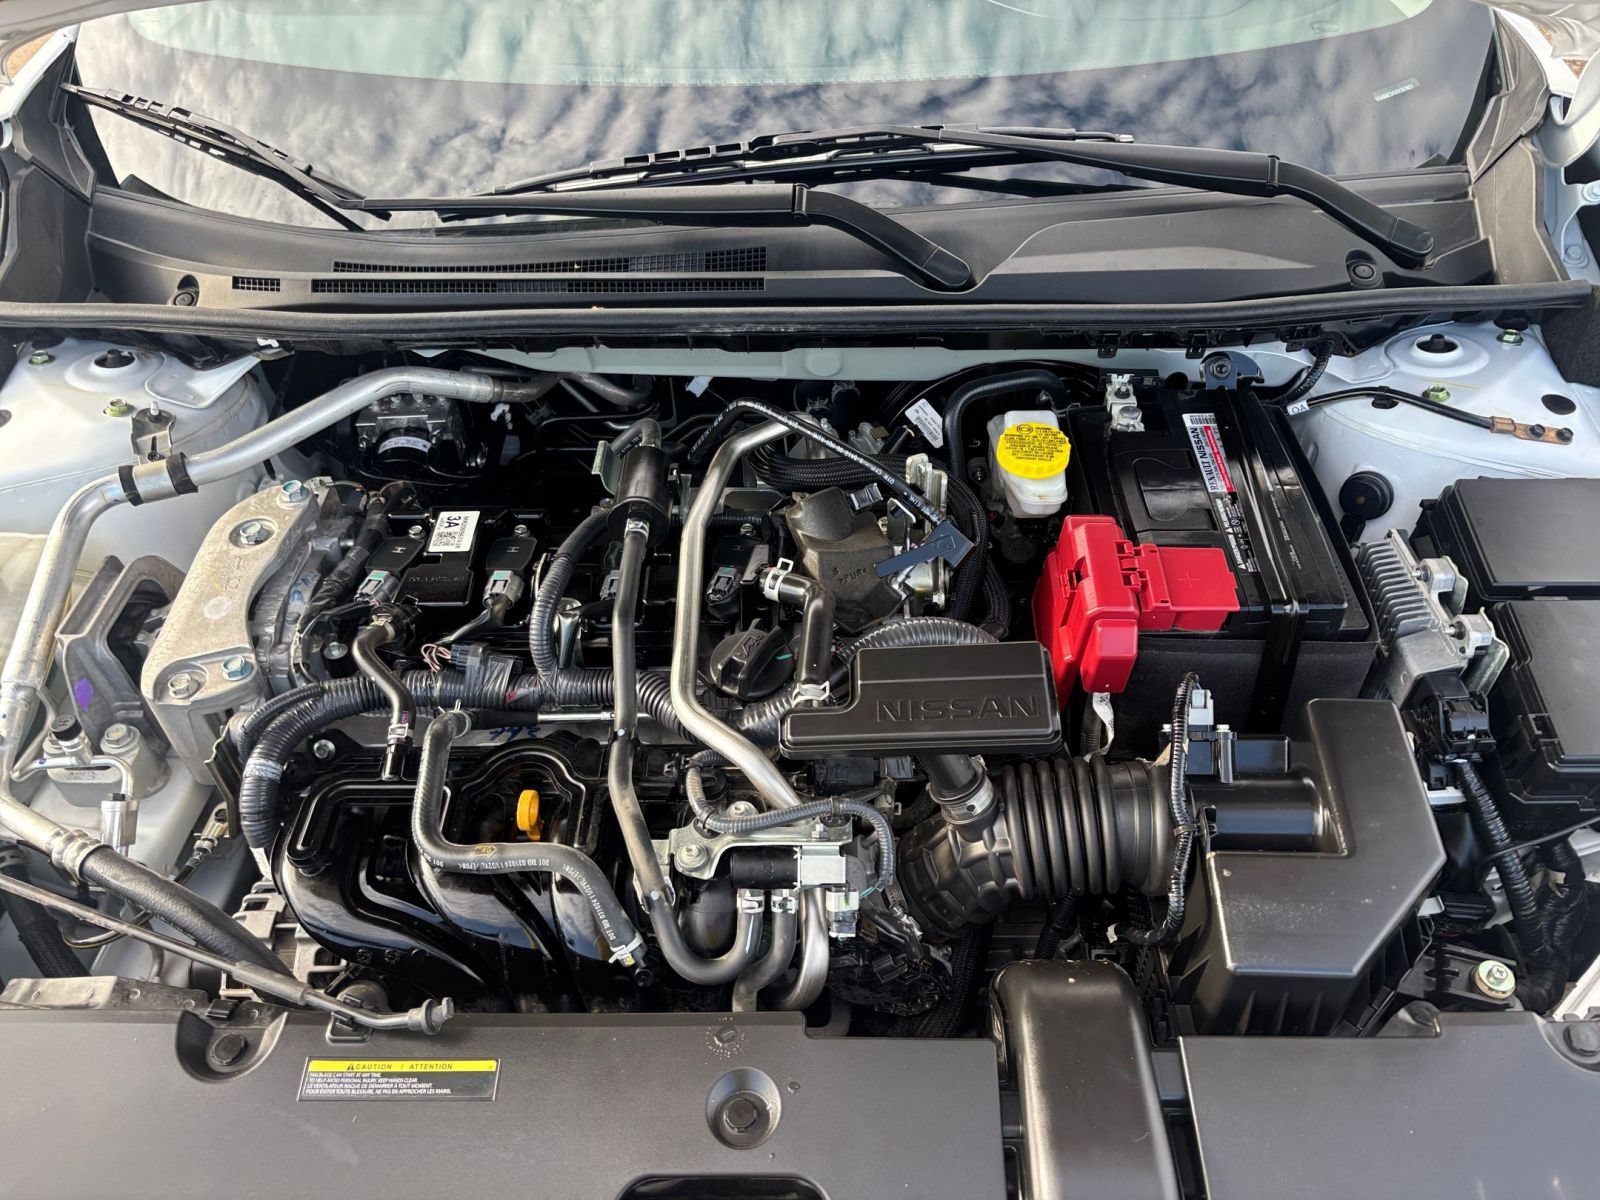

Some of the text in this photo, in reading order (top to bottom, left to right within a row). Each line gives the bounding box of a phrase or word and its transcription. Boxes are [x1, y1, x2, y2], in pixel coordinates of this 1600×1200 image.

[1190, 427, 1208, 458] NISSAN
[1201, 461, 1220, 490] RENAULT
[444, 516, 462, 528] 3A
[876, 695, 1041, 722] NISSAN
[539, 858, 550, 866] DOT
[606, 929, 616, 940] DOT
